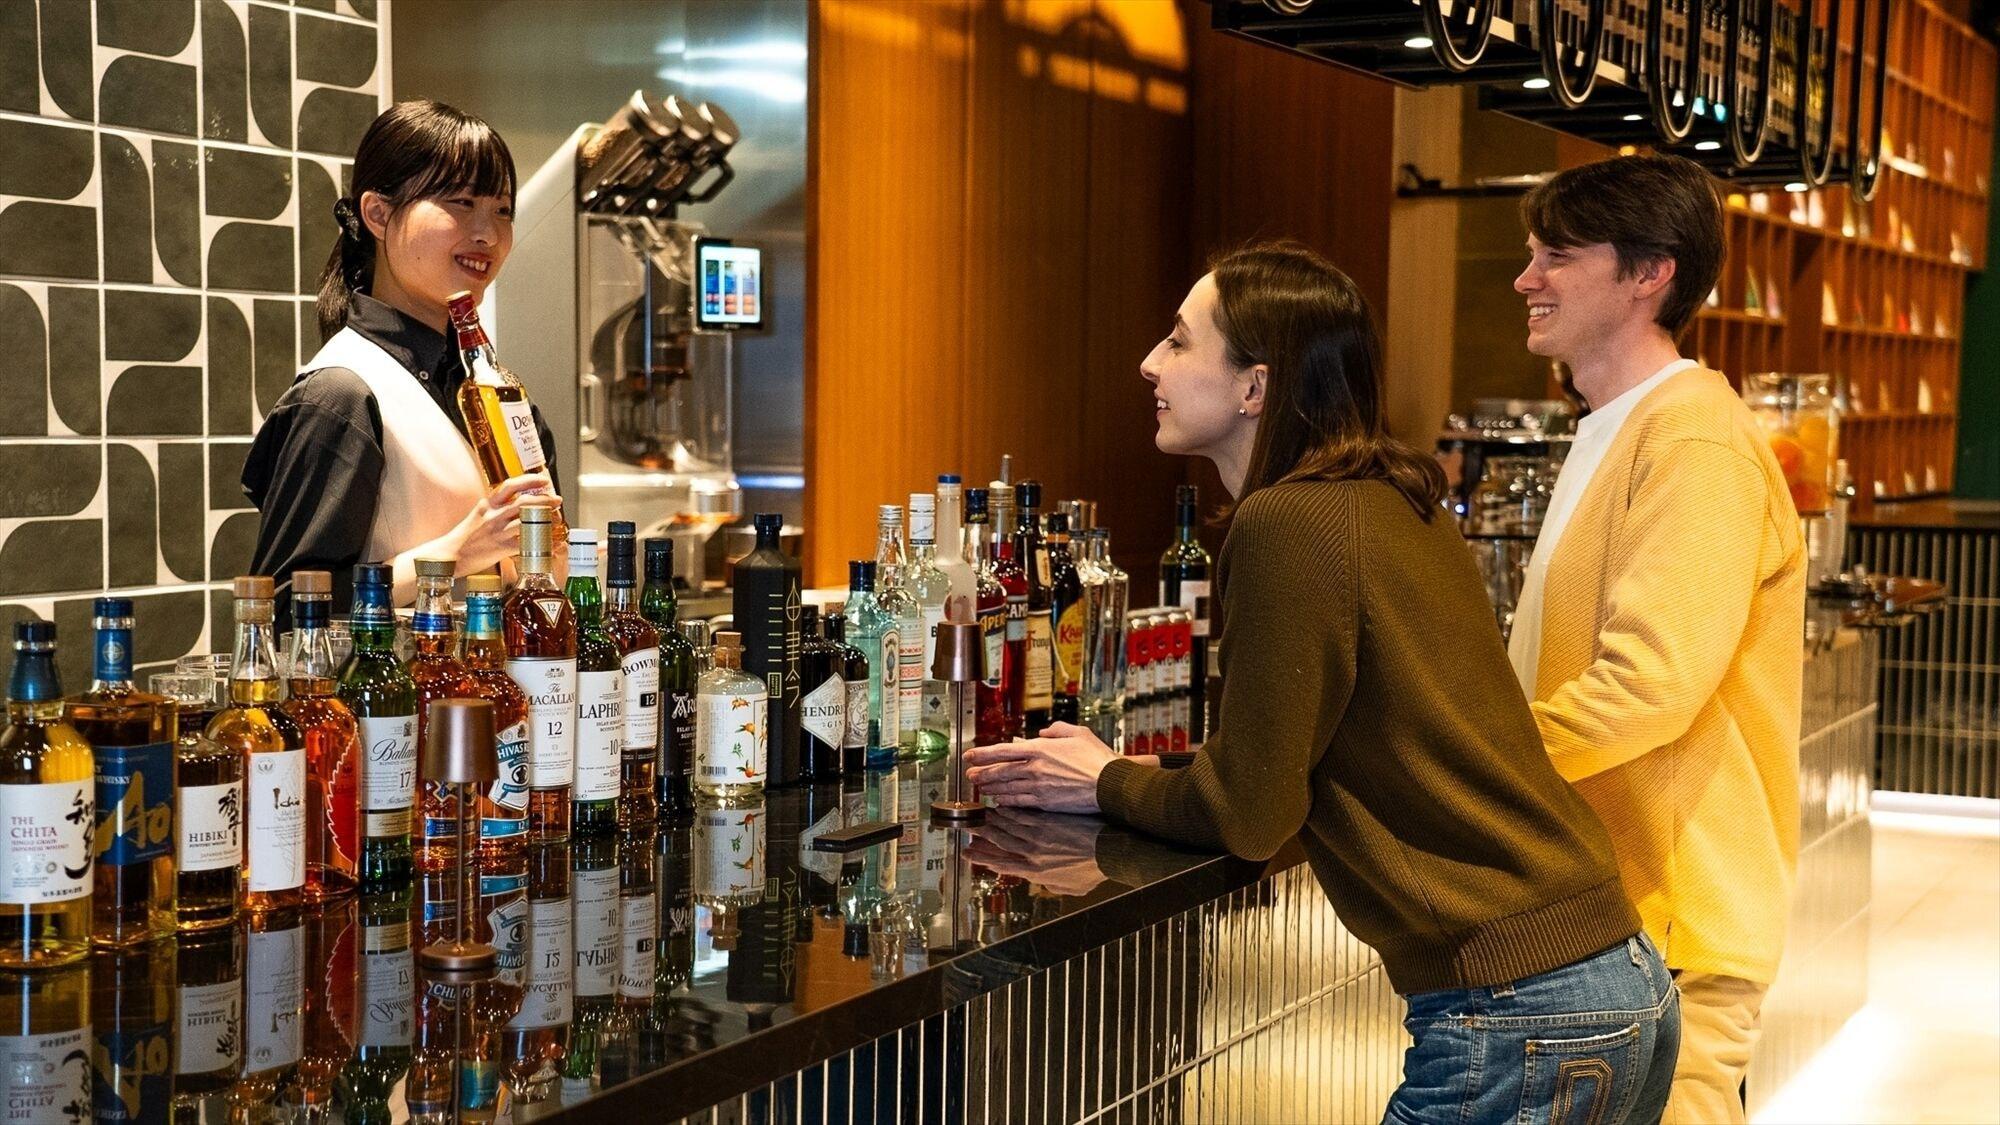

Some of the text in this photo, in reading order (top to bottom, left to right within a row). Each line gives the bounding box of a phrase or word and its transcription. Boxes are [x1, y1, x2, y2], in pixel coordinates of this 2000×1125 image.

[544, 683, 561, 694] The
[646, 694, 655, 706] 12
[547, 721, 562, 736] 12
[610, 738, 619, 756] 10
[400, 771, 410, 788] 17
[11, 816, 34, 825] THE
[11, 826, 58, 838] CHITA
[188, 830, 228, 843] HIBIKI
